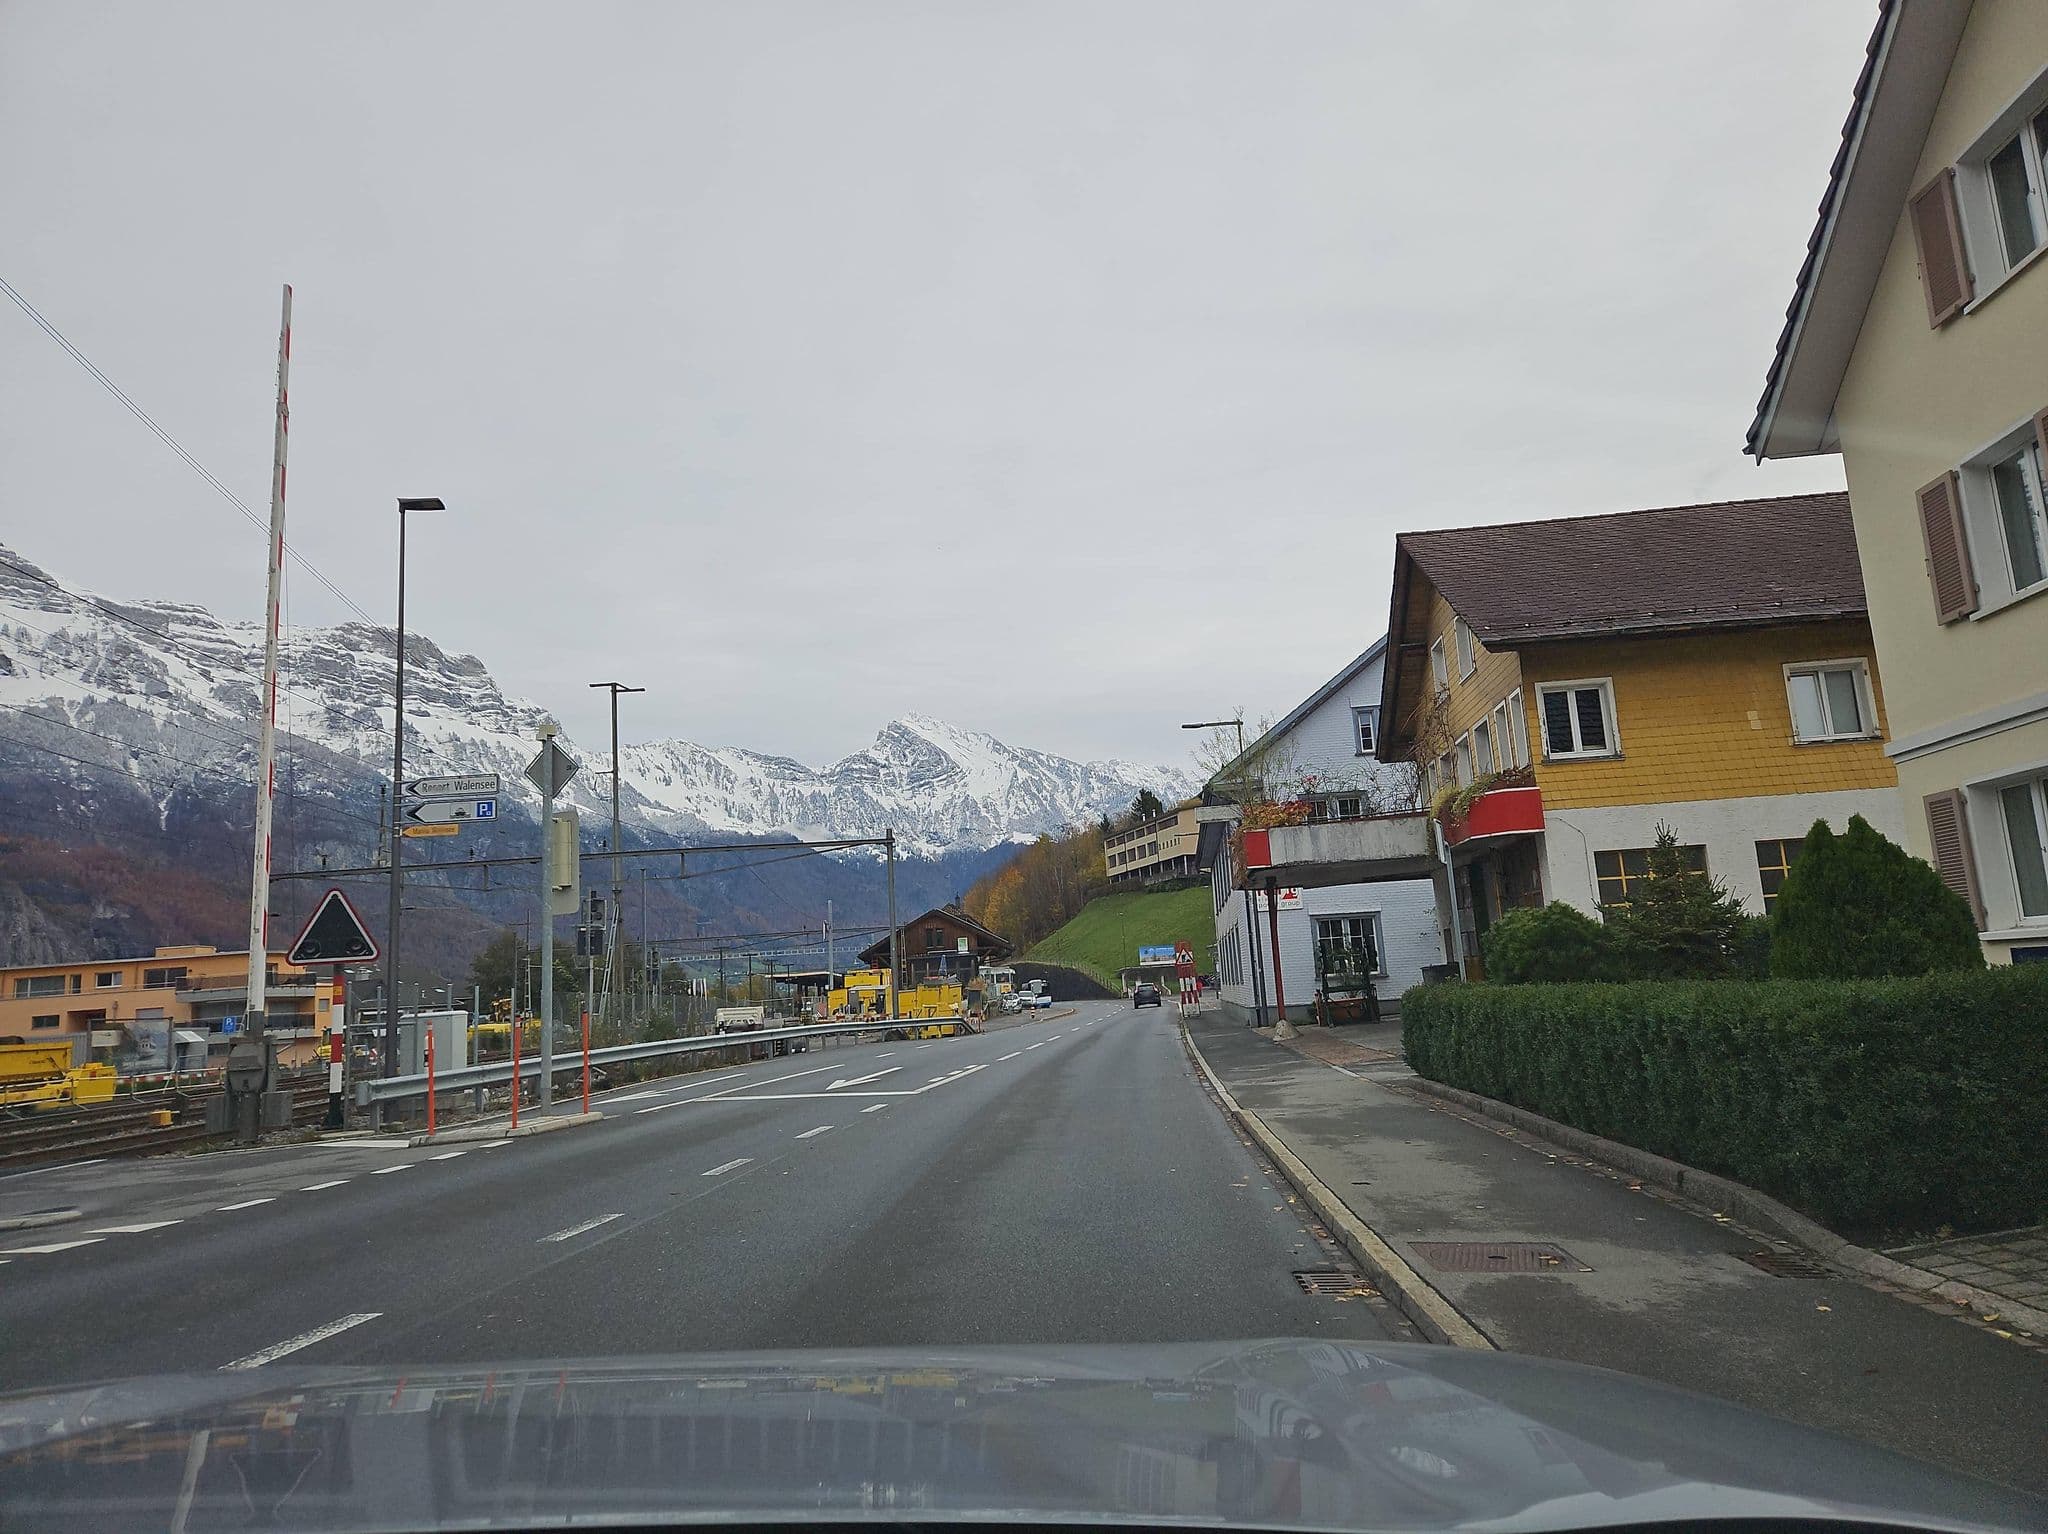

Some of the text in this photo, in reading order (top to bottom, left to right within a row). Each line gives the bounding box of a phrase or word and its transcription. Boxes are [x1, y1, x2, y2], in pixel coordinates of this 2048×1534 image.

[454, 780, 496, 791] Walensee
[479, 803, 488, 815] P
[1281, 900, 1300, 908] group
